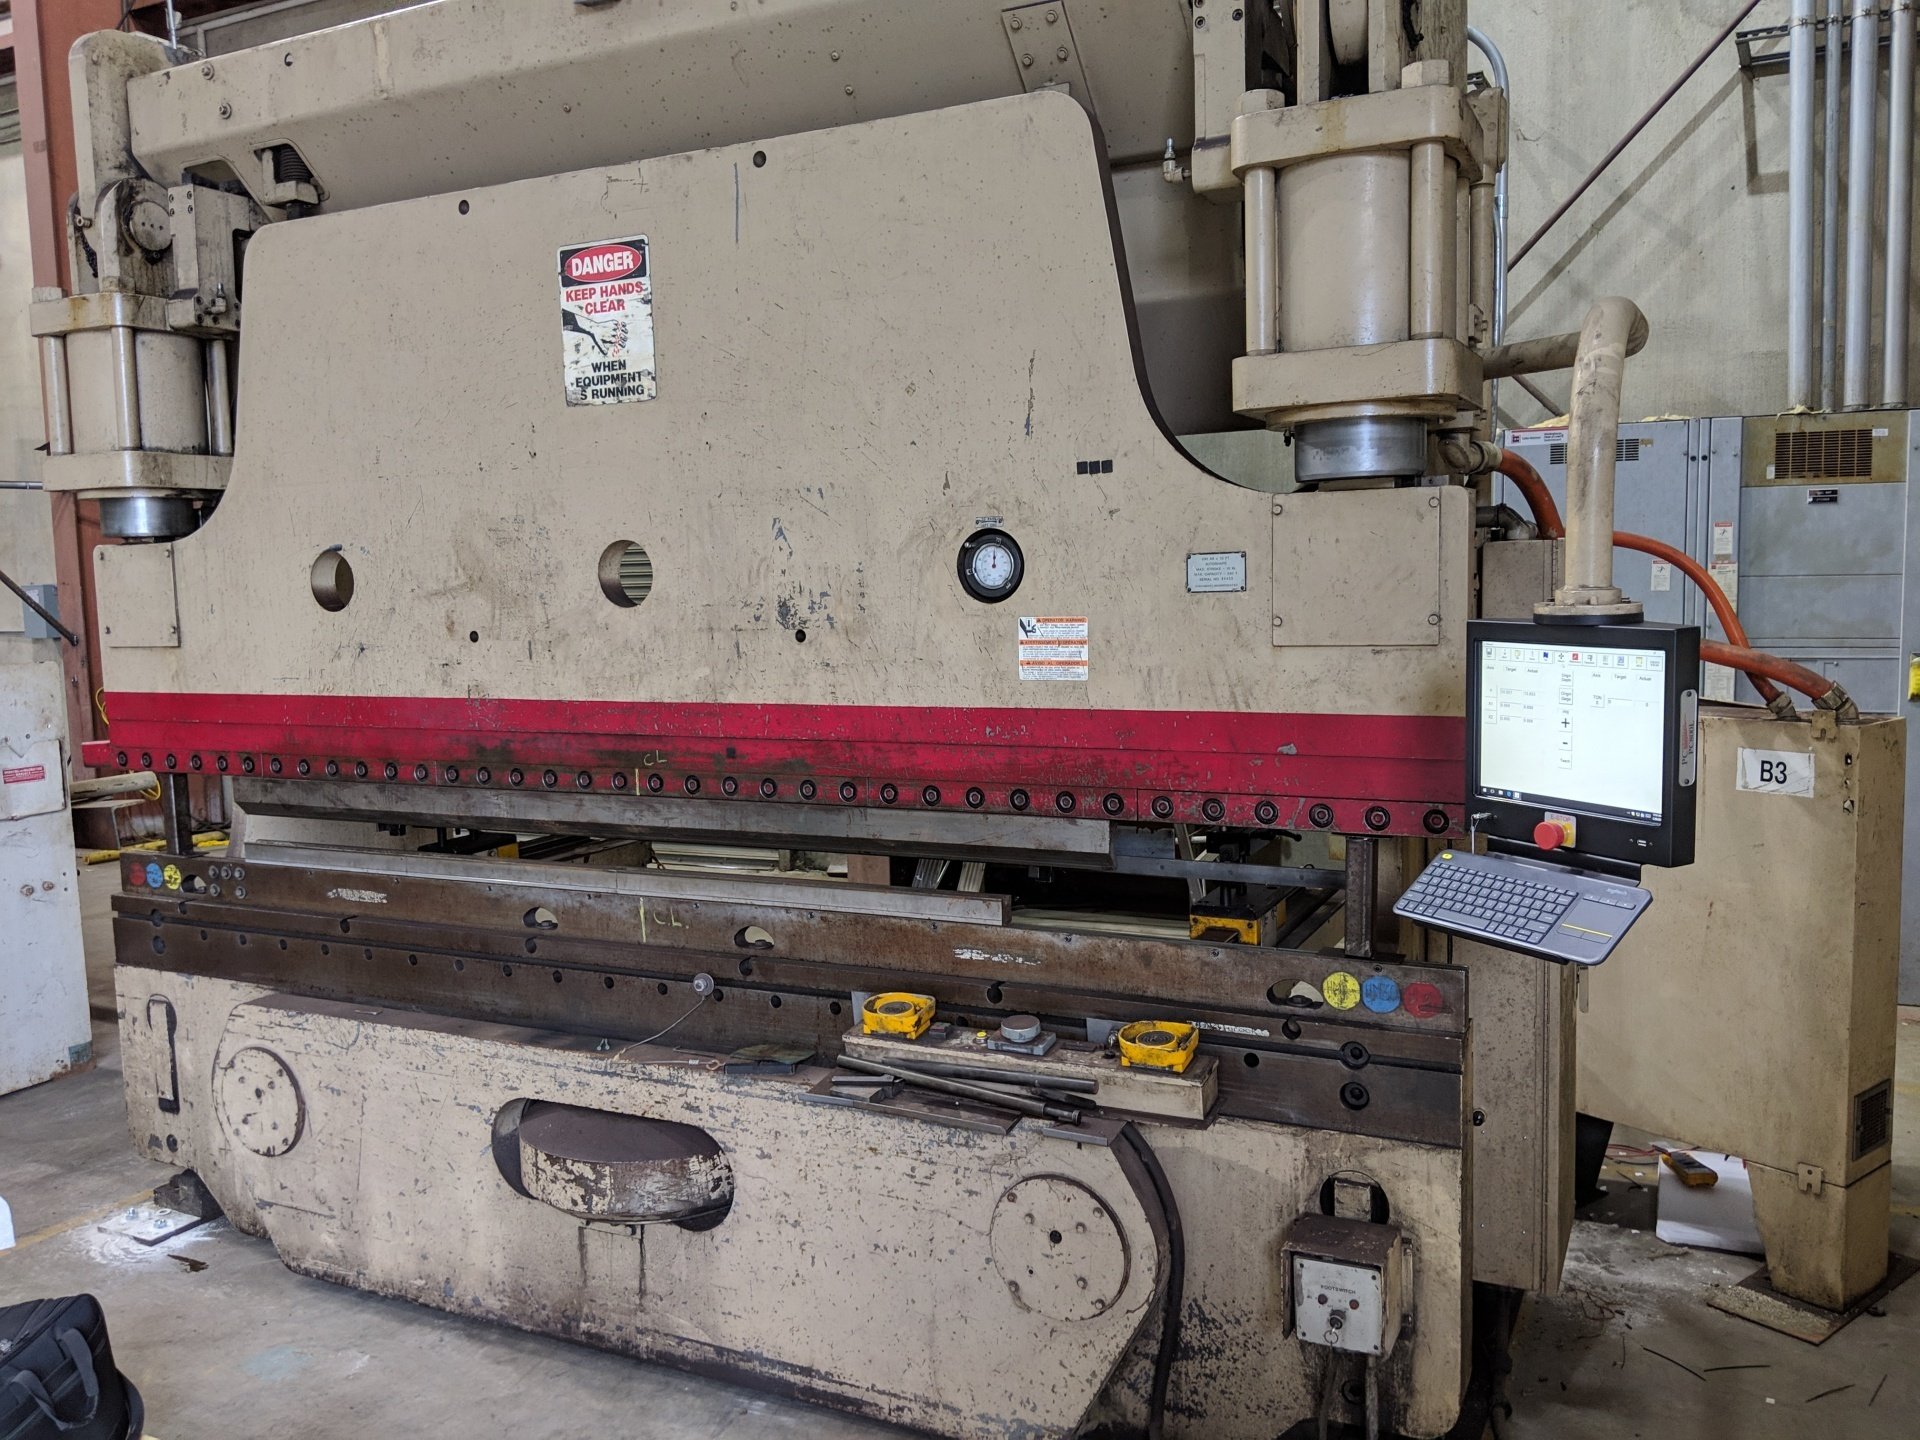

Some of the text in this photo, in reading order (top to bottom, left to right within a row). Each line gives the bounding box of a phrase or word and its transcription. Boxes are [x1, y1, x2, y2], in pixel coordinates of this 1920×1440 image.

[571, 251, 634, 277] DANGER
[565, 281, 644, 302] KEEP HANDS
[584, 299, 626, 315] CLEAR
[591, 359, 627, 373] WHEN
[575, 371, 643, 388] EQUIPMENT
[591, 384, 645, 399] RUNNING
[643, 749, 668, 766] CL
[1760, 759, 1788, 785] B3
[1320, 1284, 1356, 1294] FOOTSWITCH
